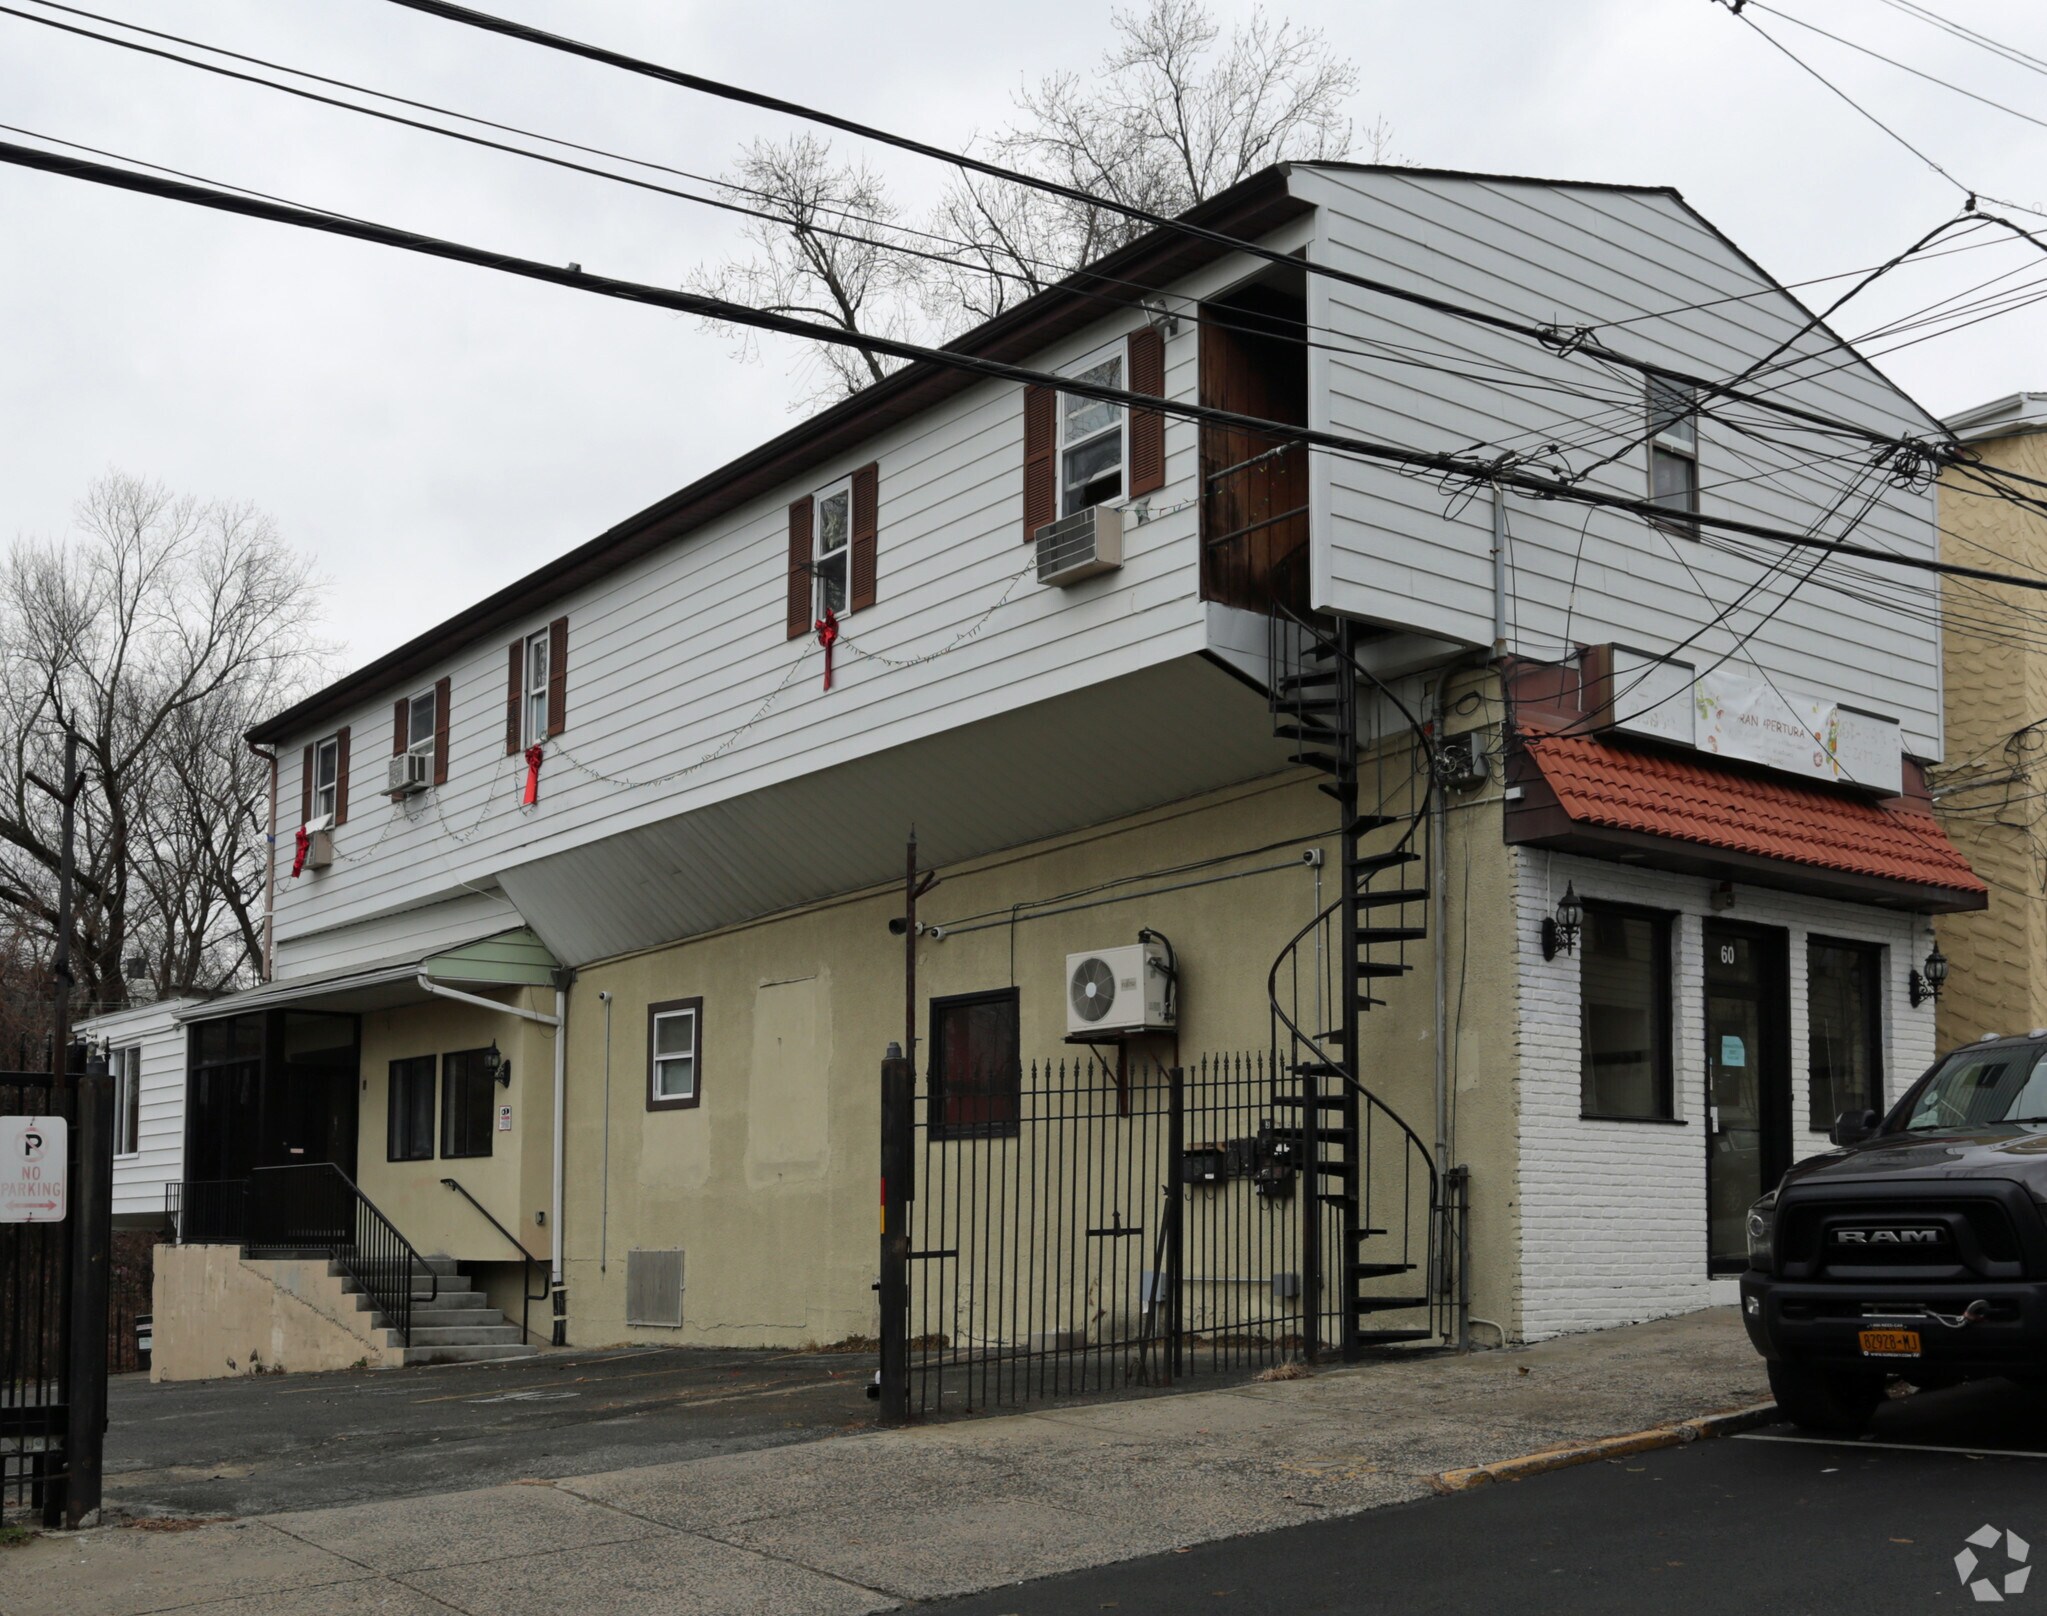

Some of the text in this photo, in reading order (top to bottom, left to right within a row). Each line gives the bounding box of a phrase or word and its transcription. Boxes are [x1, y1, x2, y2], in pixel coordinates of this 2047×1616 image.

[1721, 945, 1735, 964] 60
[22, 1166, 41, 1181] NO
[1, 1182, 61, 1197] PARKING
[1838, 1230, 1938, 1243] RAM
